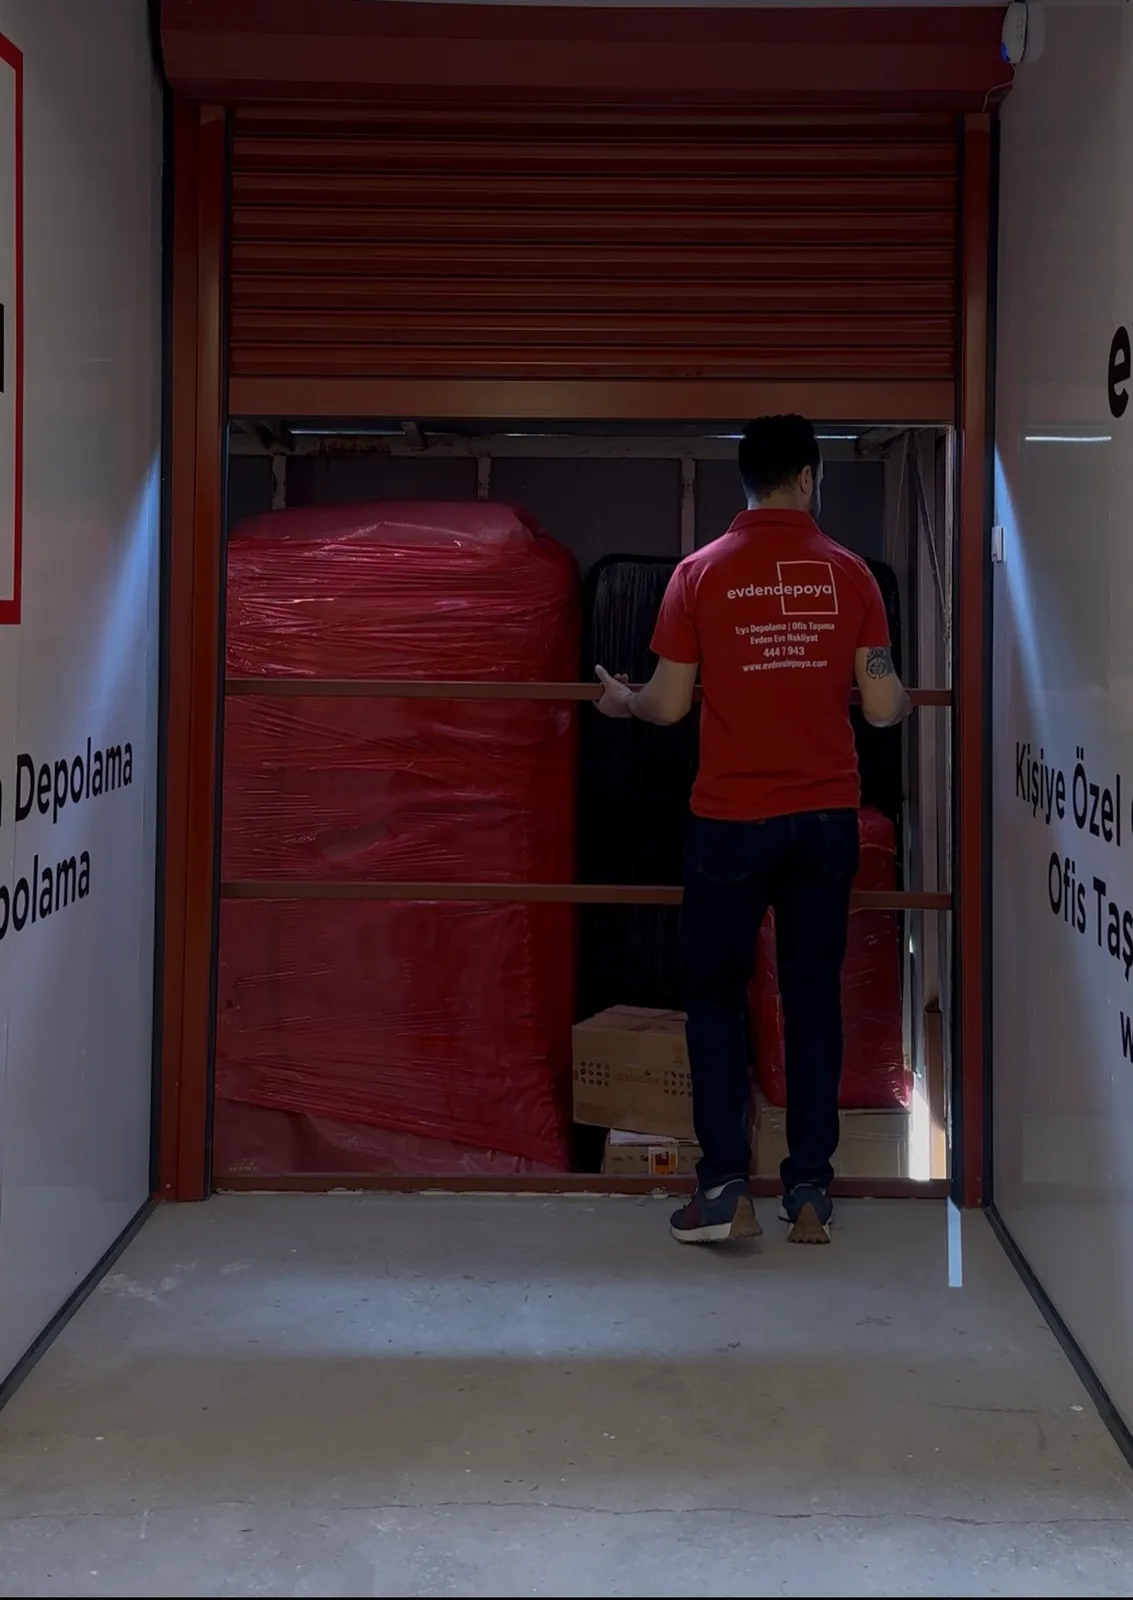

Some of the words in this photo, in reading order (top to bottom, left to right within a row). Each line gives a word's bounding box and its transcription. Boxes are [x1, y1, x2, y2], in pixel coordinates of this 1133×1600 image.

[1107, 326, 1132, 419] e
[727, 583, 832, 599] evdendepoya
[750, 623, 787, 634] Depolama
[792, 621, 807, 630] Ofis
[750, 635, 773, 645] Evden
[774, 634, 786, 643] Eve
[787, 633, 819, 643] Nakliyat
[742, 659, 828, 672] www.evdendepoya.com
[15, 737, 132, 824] Depolama
[1016, 741, 1066, 825] Kişiye
[1073, 746, 1121, 846] Özel
[1049, 852, 1086, 934] Ofis
